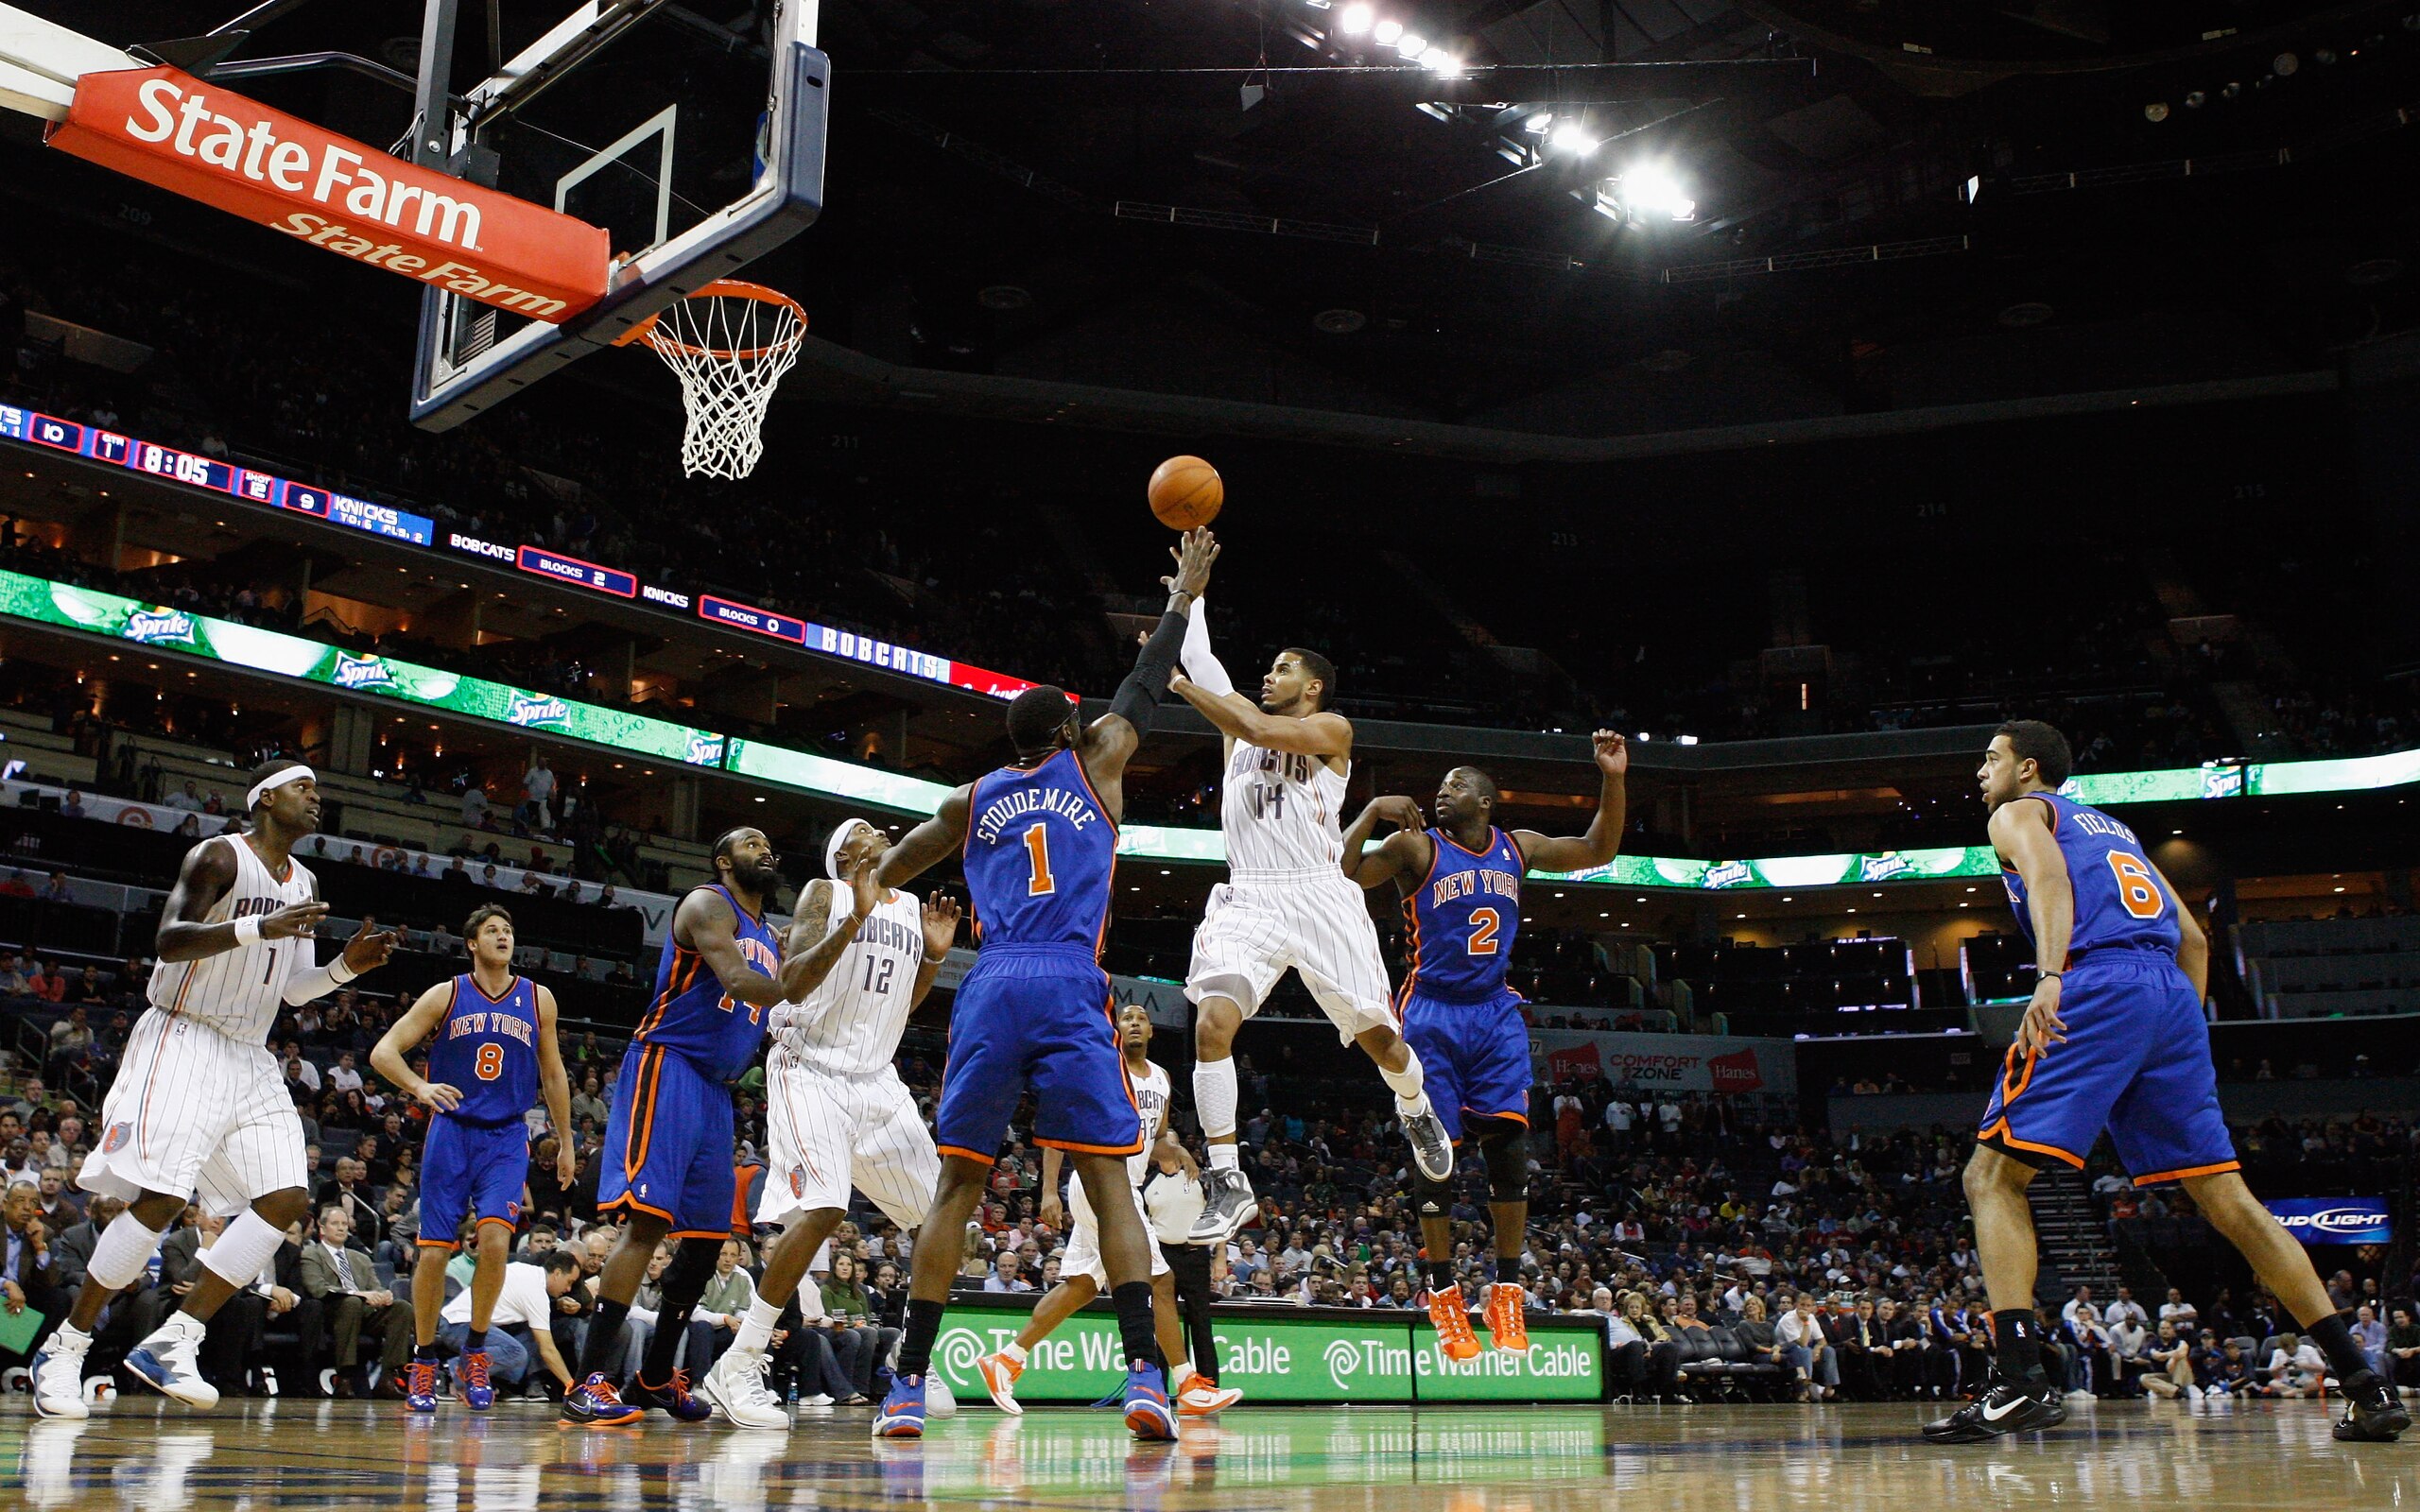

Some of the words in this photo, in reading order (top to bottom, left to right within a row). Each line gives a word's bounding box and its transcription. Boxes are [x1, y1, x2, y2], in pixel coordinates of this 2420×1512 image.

[126, 78, 310, 192] State
[313, 144, 482, 250] Farm
[118, 201, 151, 226] 209
[269, 213, 426, 273] State
[418, 261, 567, 317] Farm
[43, 423, 64, 442] 10
[831, 434, 859, 449] 211
[105, 442, 112, 458] 1
[145, 445, 210, 486] 8:05
[245, 472, 271, 484] SHOT
[300, 493, 315, 510] 9
[334, 495, 399, 526] KNICKS
[450, 533, 516, 563] BOBCATS
[539, 558, 583, 578] BLOCKS
[593, 571, 606, 587] 2
[643, 585, 689, 608] KNICKS
[125, 612, 192, 644] Sprite
[718, 607, 758, 626] BLOCKS
[767, 618, 780, 632] 0
[822, 627, 939, 679] BOBCATS
[509, 696, 567, 727] Sprite
[977, 787, 1097, 846] STOUDEMIRE
[1254, 782, 1286, 820] 14
[2072, 813, 2136, 846] FIELDS
[1023, 822, 1056, 897] 1
[1704, 860, 1747, 890] Sprite
[1432, 869, 1475, 909] NEW
[2106, 850, 2165, 919] 6
[1468, 907, 1500, 955] 2
[263, 947, 277, 986] 1
[863, 954, 895, 995] 12
[449, 1012, 487, 1040] NEW
[491, 1012, 533, 1048] YORK
[474, 1042, 505, 1081] 8
[1610, 1053, 1702, 1069] COMFORT
[1632, 1067, 1683, 1080] ZONE
[1715, 1064, 1756, 1079] Hanes
[2320, 1214, 2389, 1226] LIGHT
[1217, 1336, 1290, 1374] Cable
[1361, 1340, 1432, 1377] Time
[1528, 1342, 1592, 1377] Cable
